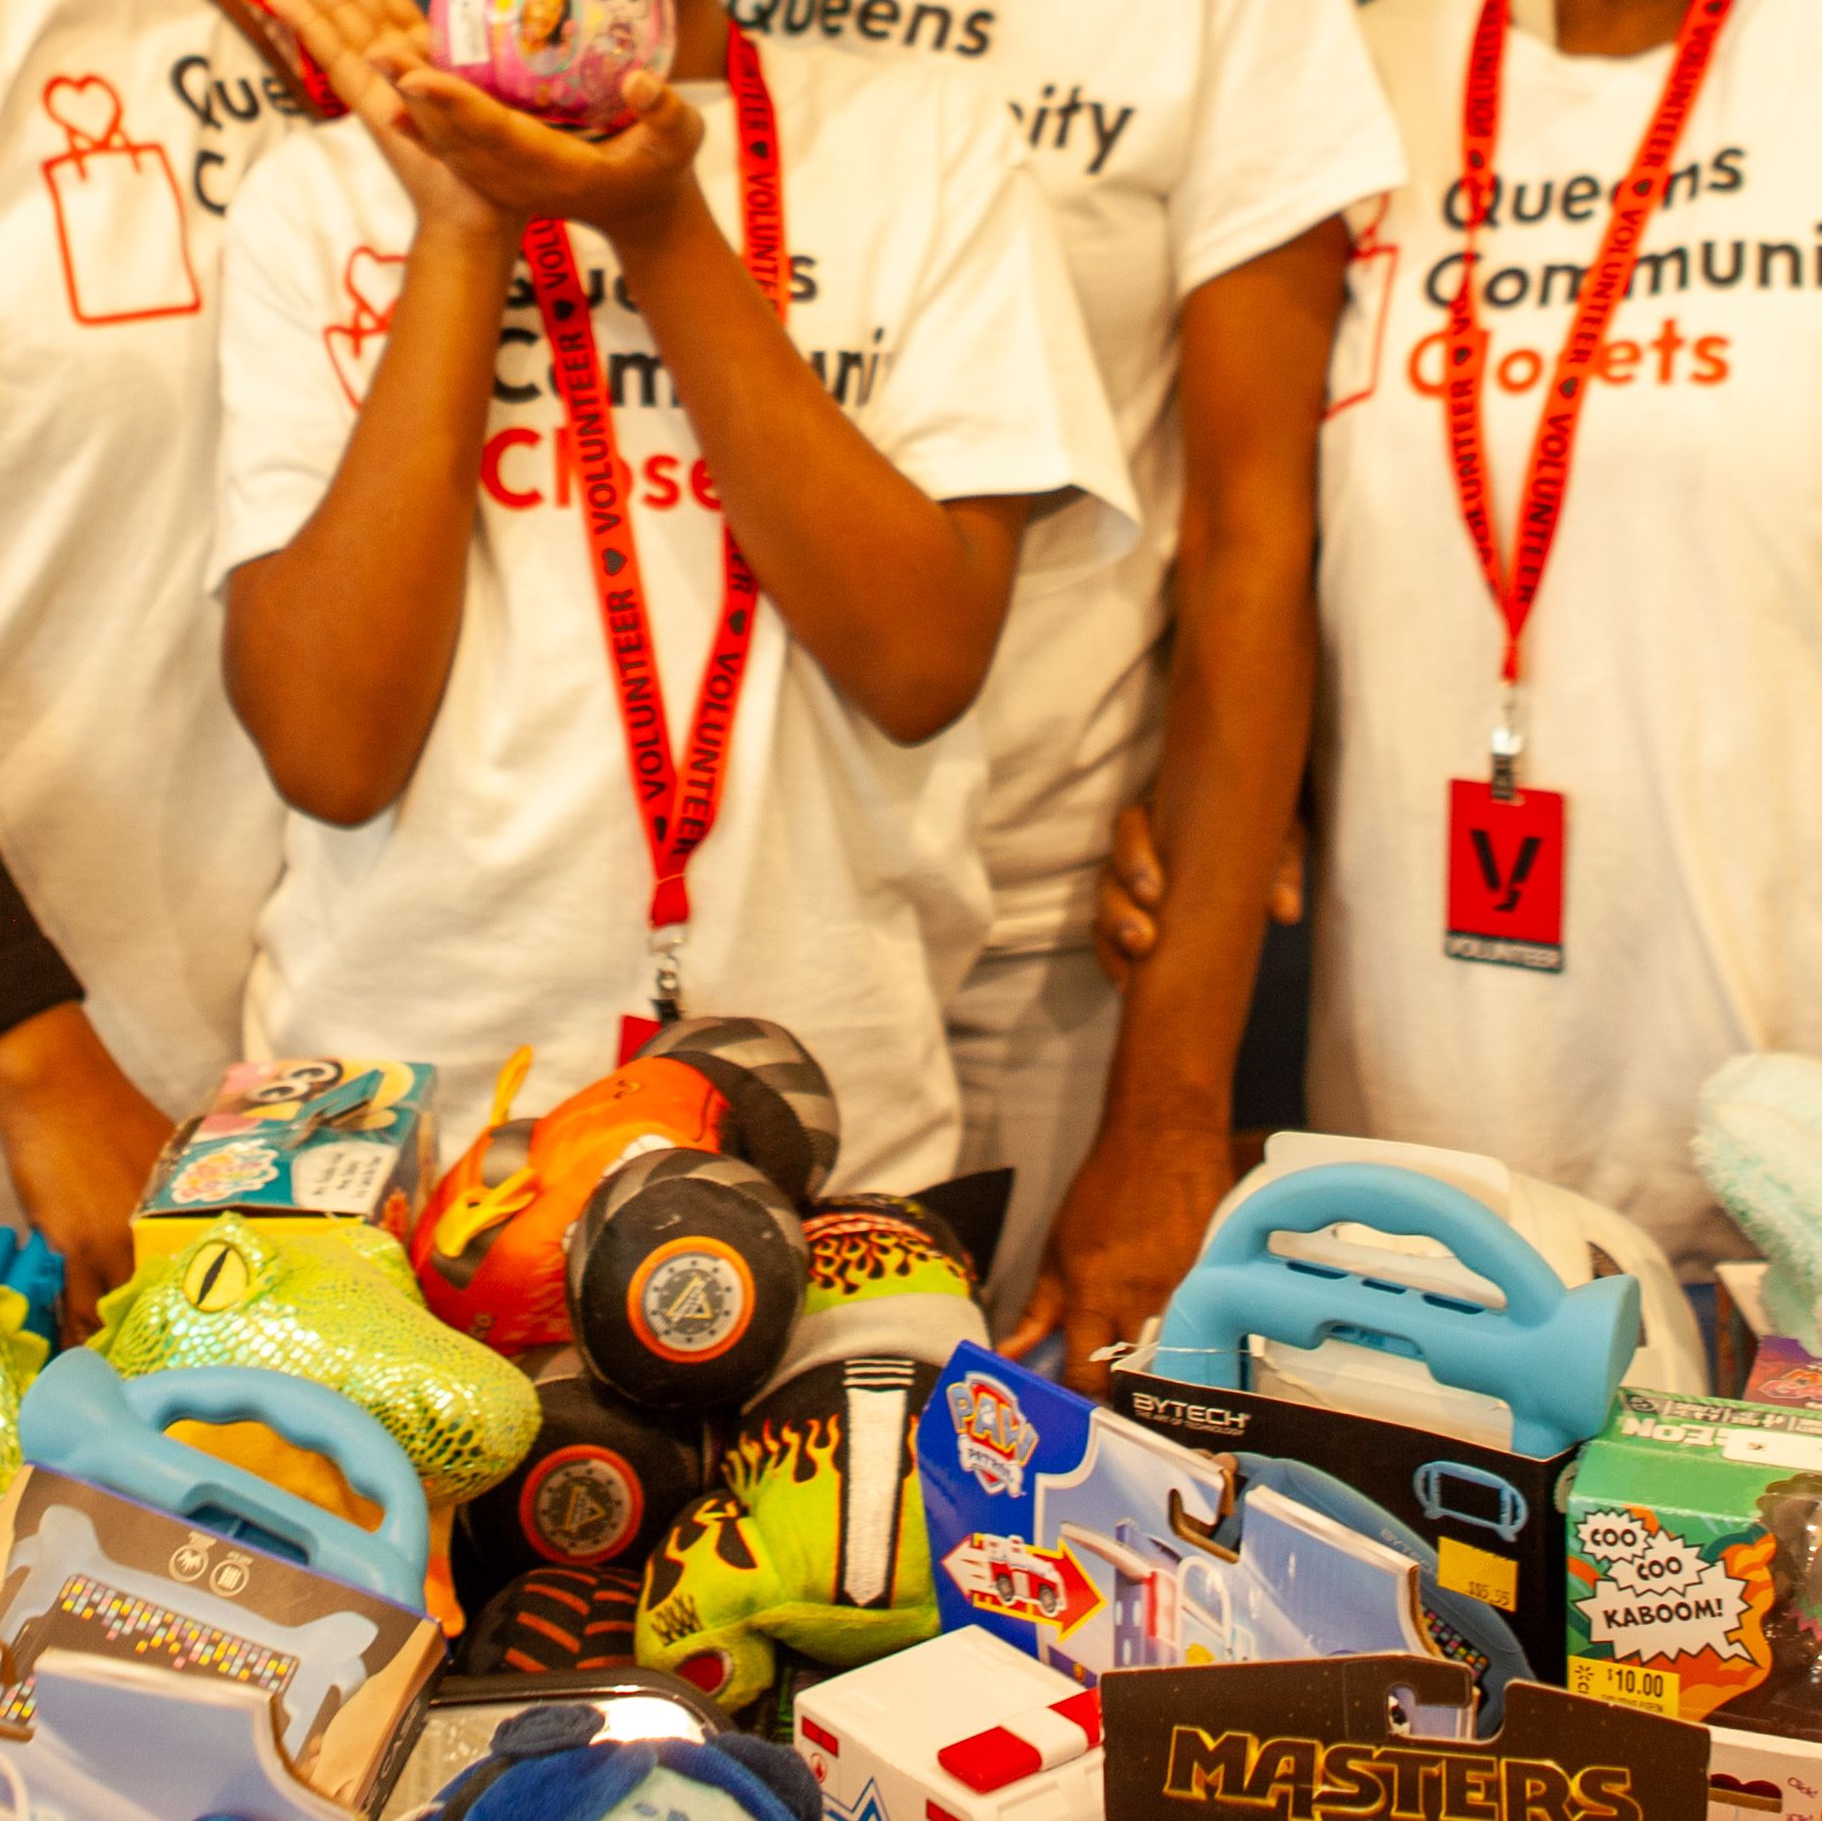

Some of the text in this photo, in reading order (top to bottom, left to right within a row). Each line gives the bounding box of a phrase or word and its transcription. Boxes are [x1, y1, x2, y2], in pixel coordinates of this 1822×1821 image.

[170, 54, 307, 131] Que
[1570, 208, 1644, 365] VOLUNTEER
[557, 332, 624, 535] VOLUNTEER
[1517, 412, 1573, 604] VOLUNTEER
[605, 586, 664, 803] VOLUNTEER
[946, 1380, 1041, 1468] PAW
[1130, 1390, 1249, 1430] BYTECH
[1589, 1526, 1639, 1549] COO
[1635, 1555, 1684, 1582] COO
[1601, 1595, 1727, 1632] KABOOM!
[1607, 1668, 1665, 1699] $10.00
[1163, 1725, 1646, 1821] MASTERS
